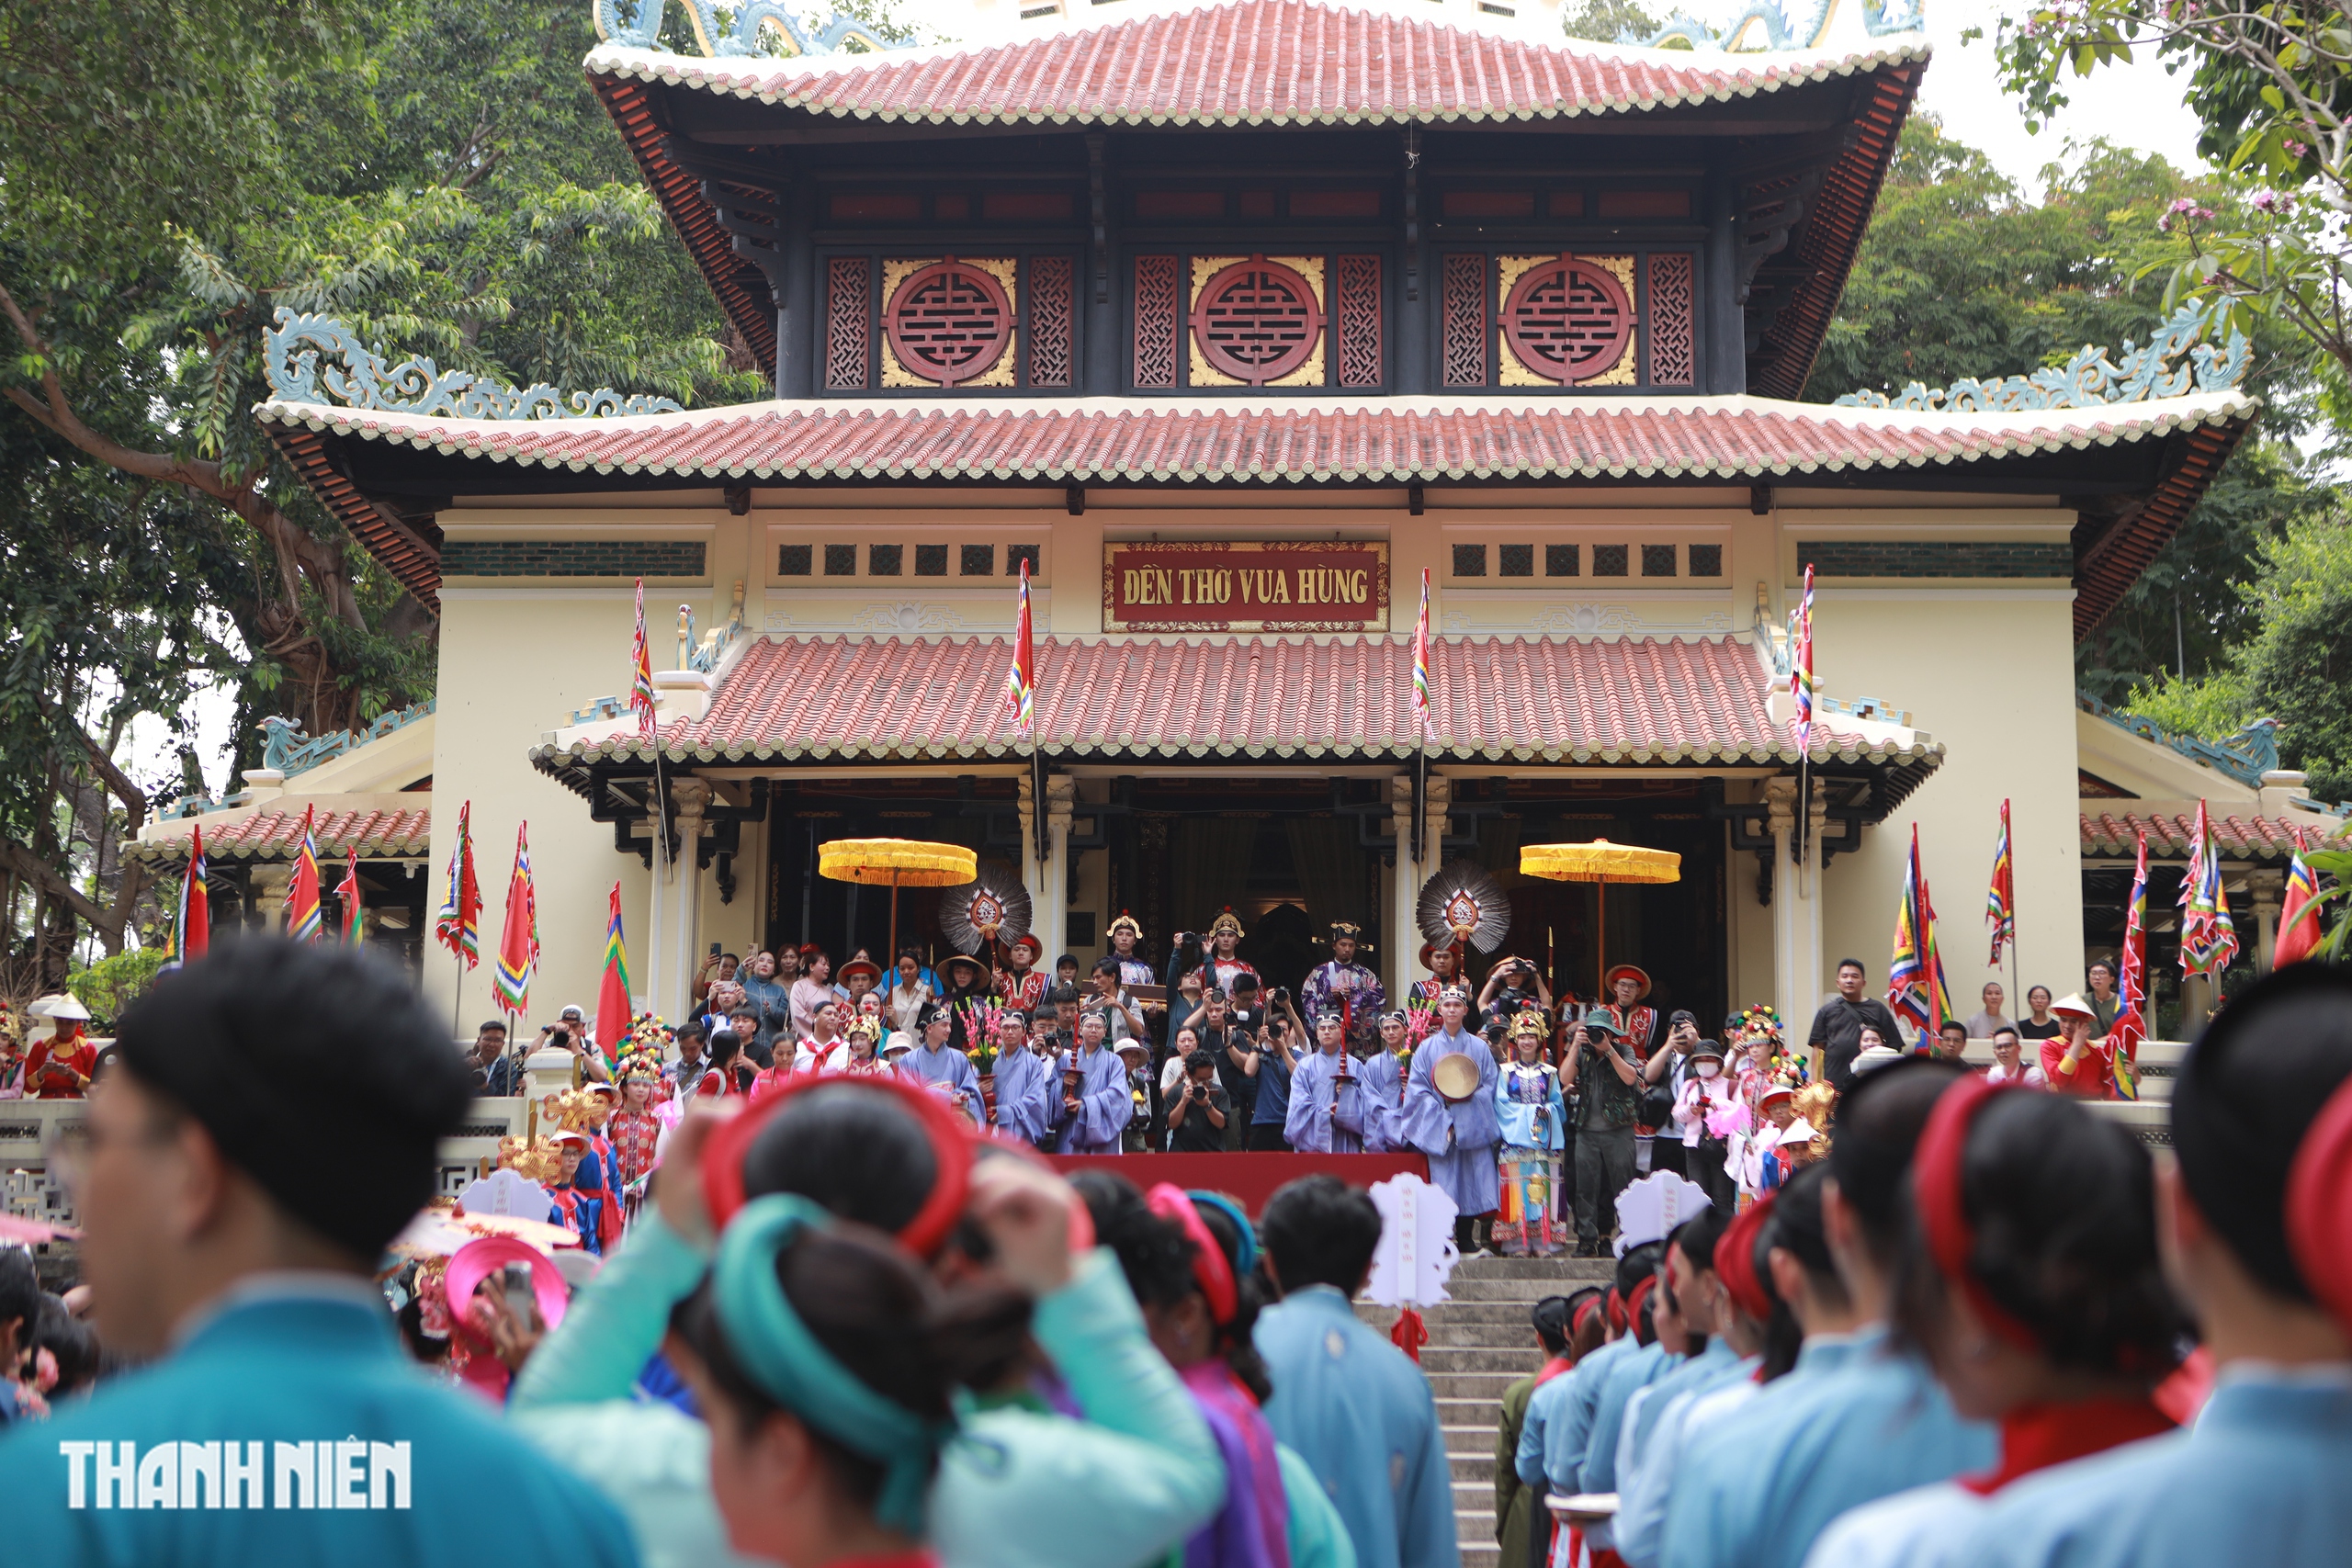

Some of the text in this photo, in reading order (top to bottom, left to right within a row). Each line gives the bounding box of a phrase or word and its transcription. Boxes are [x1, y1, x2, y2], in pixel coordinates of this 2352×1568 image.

[1124, 563, 1369, 605] ĐỀN THỜ VUA HÙNG
